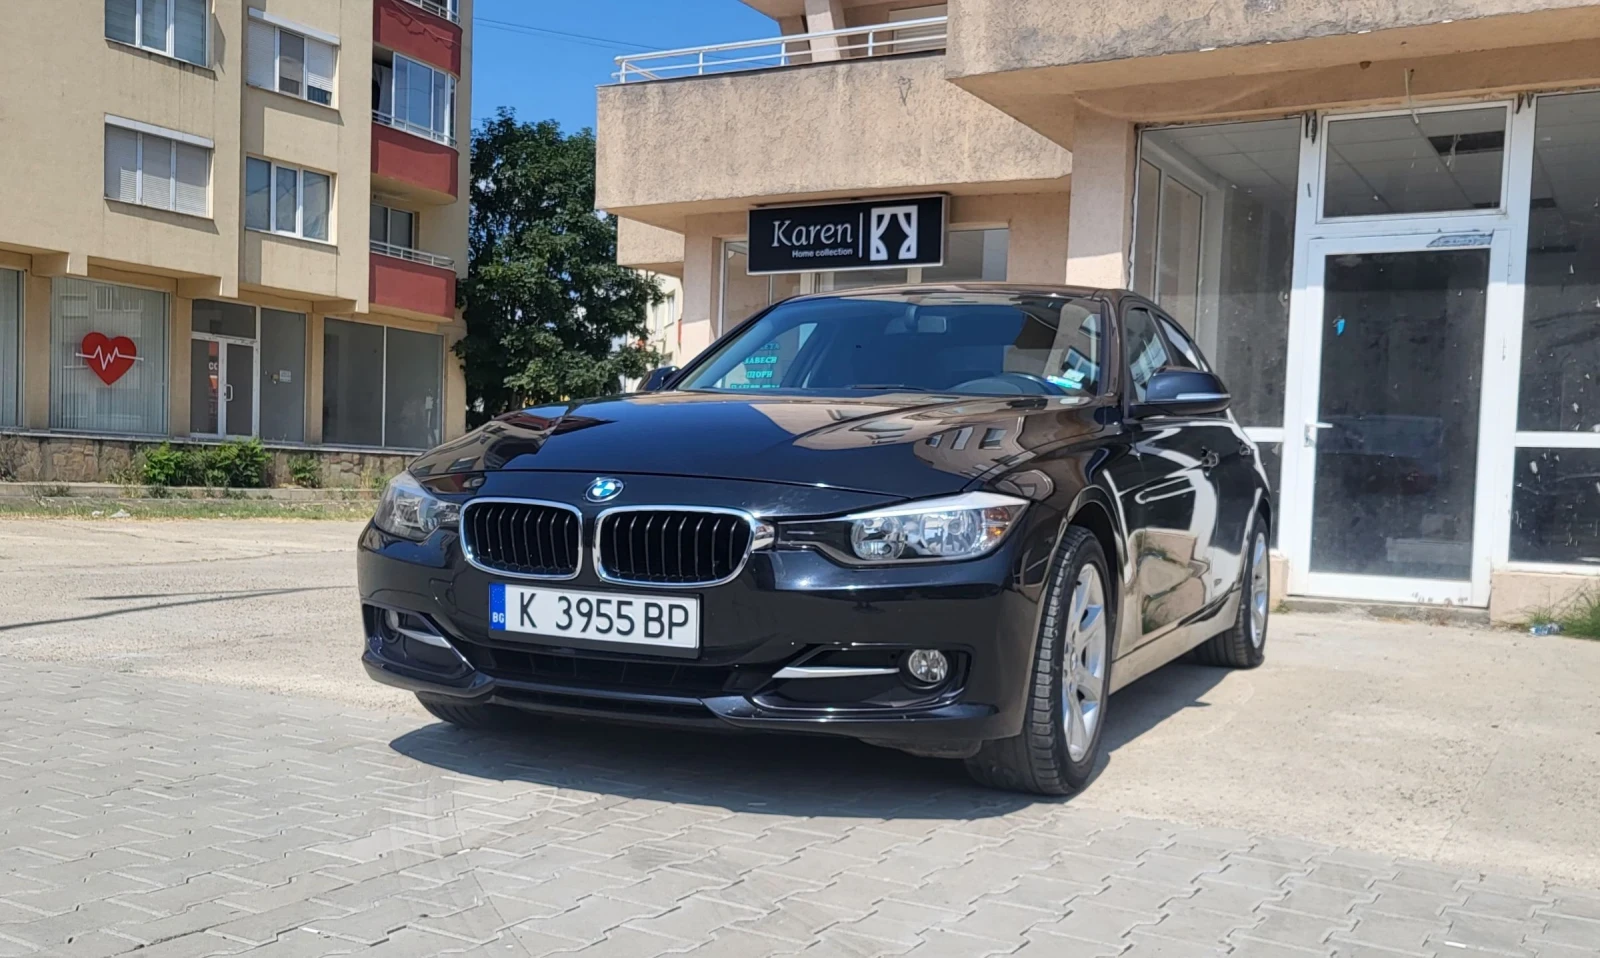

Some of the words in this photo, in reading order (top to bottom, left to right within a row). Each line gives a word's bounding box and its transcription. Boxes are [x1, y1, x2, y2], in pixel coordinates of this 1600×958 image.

[771, 219, 853, 247] Karen
[791, 250, 814, 259] Home
[815, 248, 853, 257] collection
[492, 611, 505, 624] BG
[519, 591, 538, 629] K
[555, 595, 636, 637] 3955
[643, 602, 690, 640] BP
